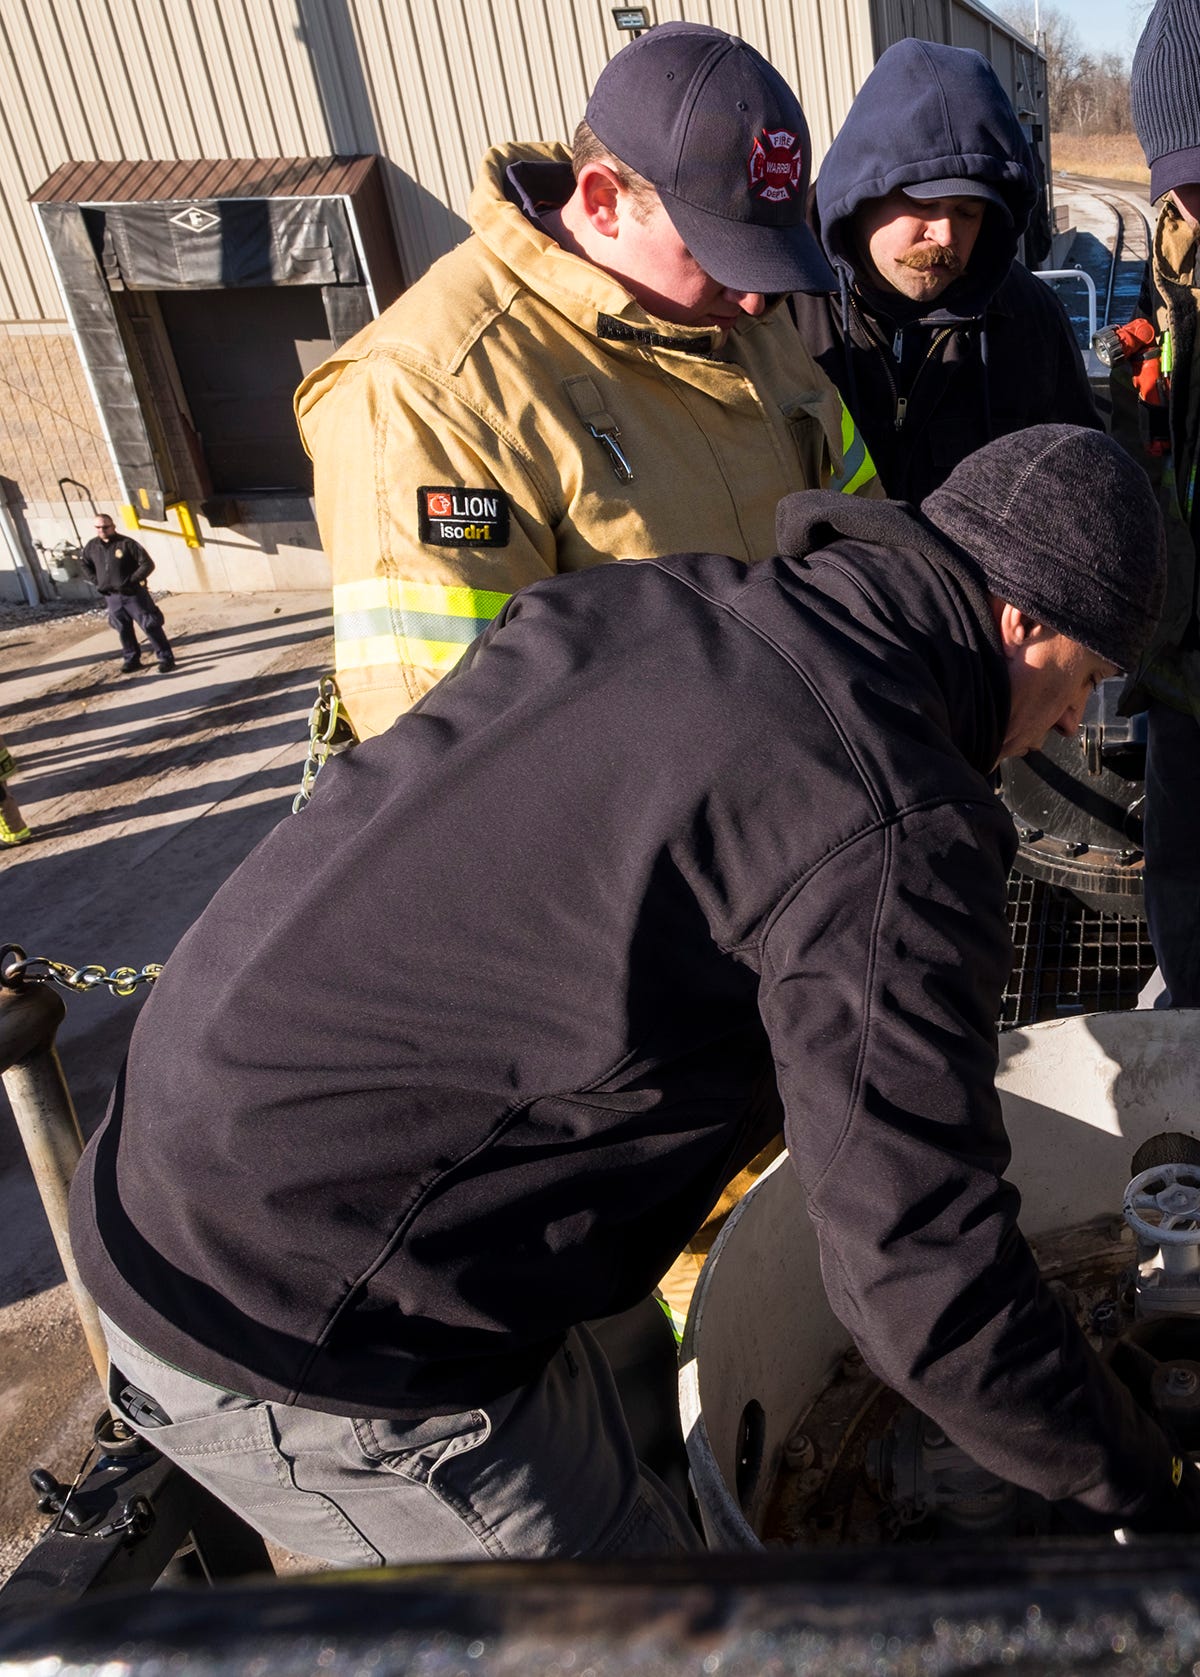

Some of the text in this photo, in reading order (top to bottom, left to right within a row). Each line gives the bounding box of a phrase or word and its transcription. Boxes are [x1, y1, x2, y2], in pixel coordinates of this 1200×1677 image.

[774, 136, 791, 146] FIRE
[452, 495, 497, 517] LION
[440, 522, 490, 540] isodri
